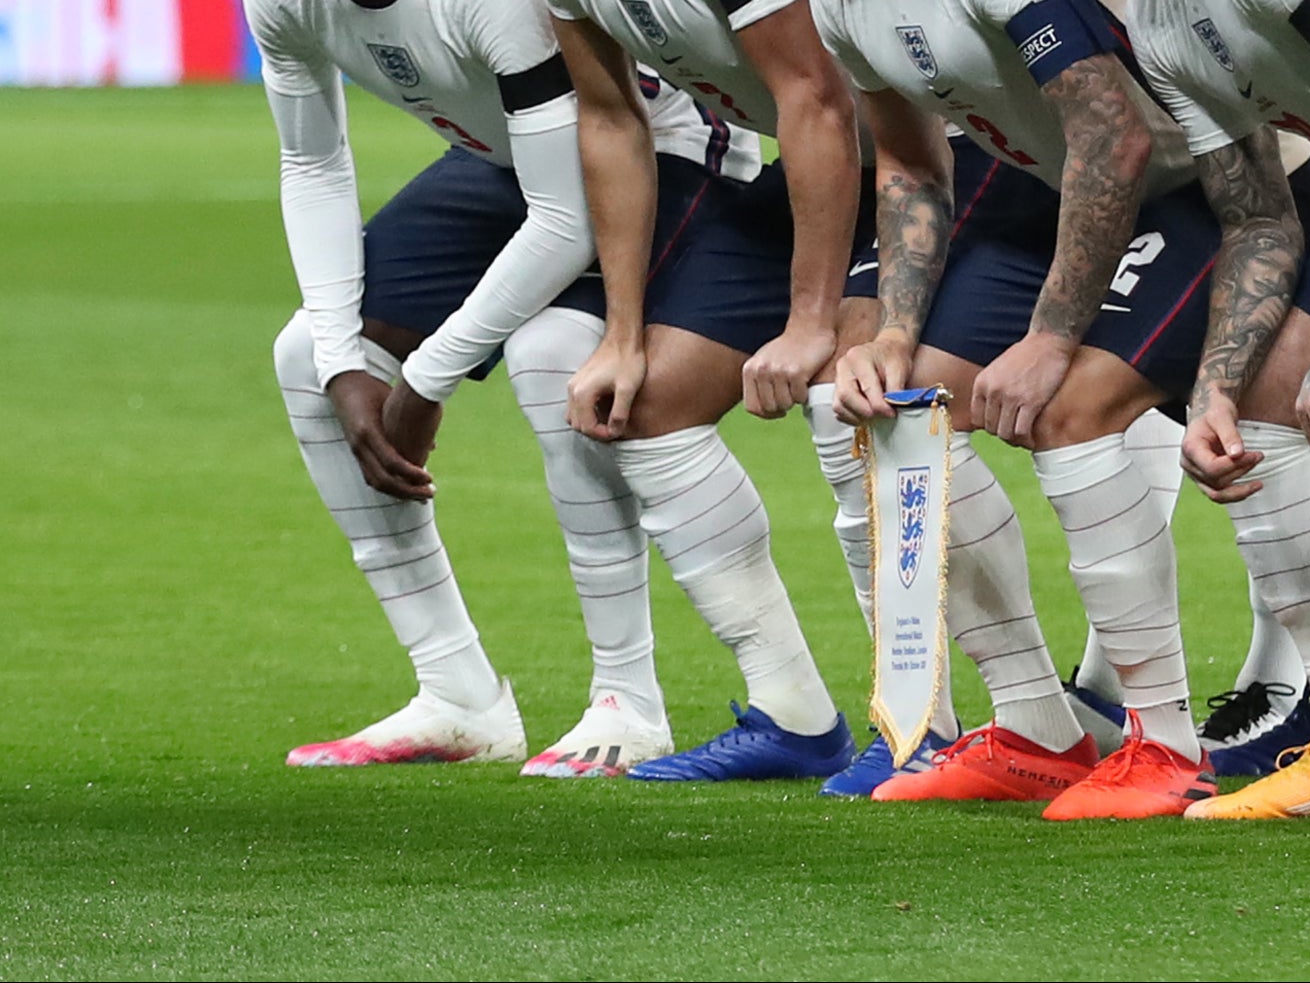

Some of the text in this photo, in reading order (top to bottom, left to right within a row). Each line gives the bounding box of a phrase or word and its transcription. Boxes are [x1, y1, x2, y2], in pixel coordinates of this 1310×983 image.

[1020, 27, 1056, 63] SPECT
[966, 113, 1040, 165] 2
[1110, 232, 1165, 296] 2
